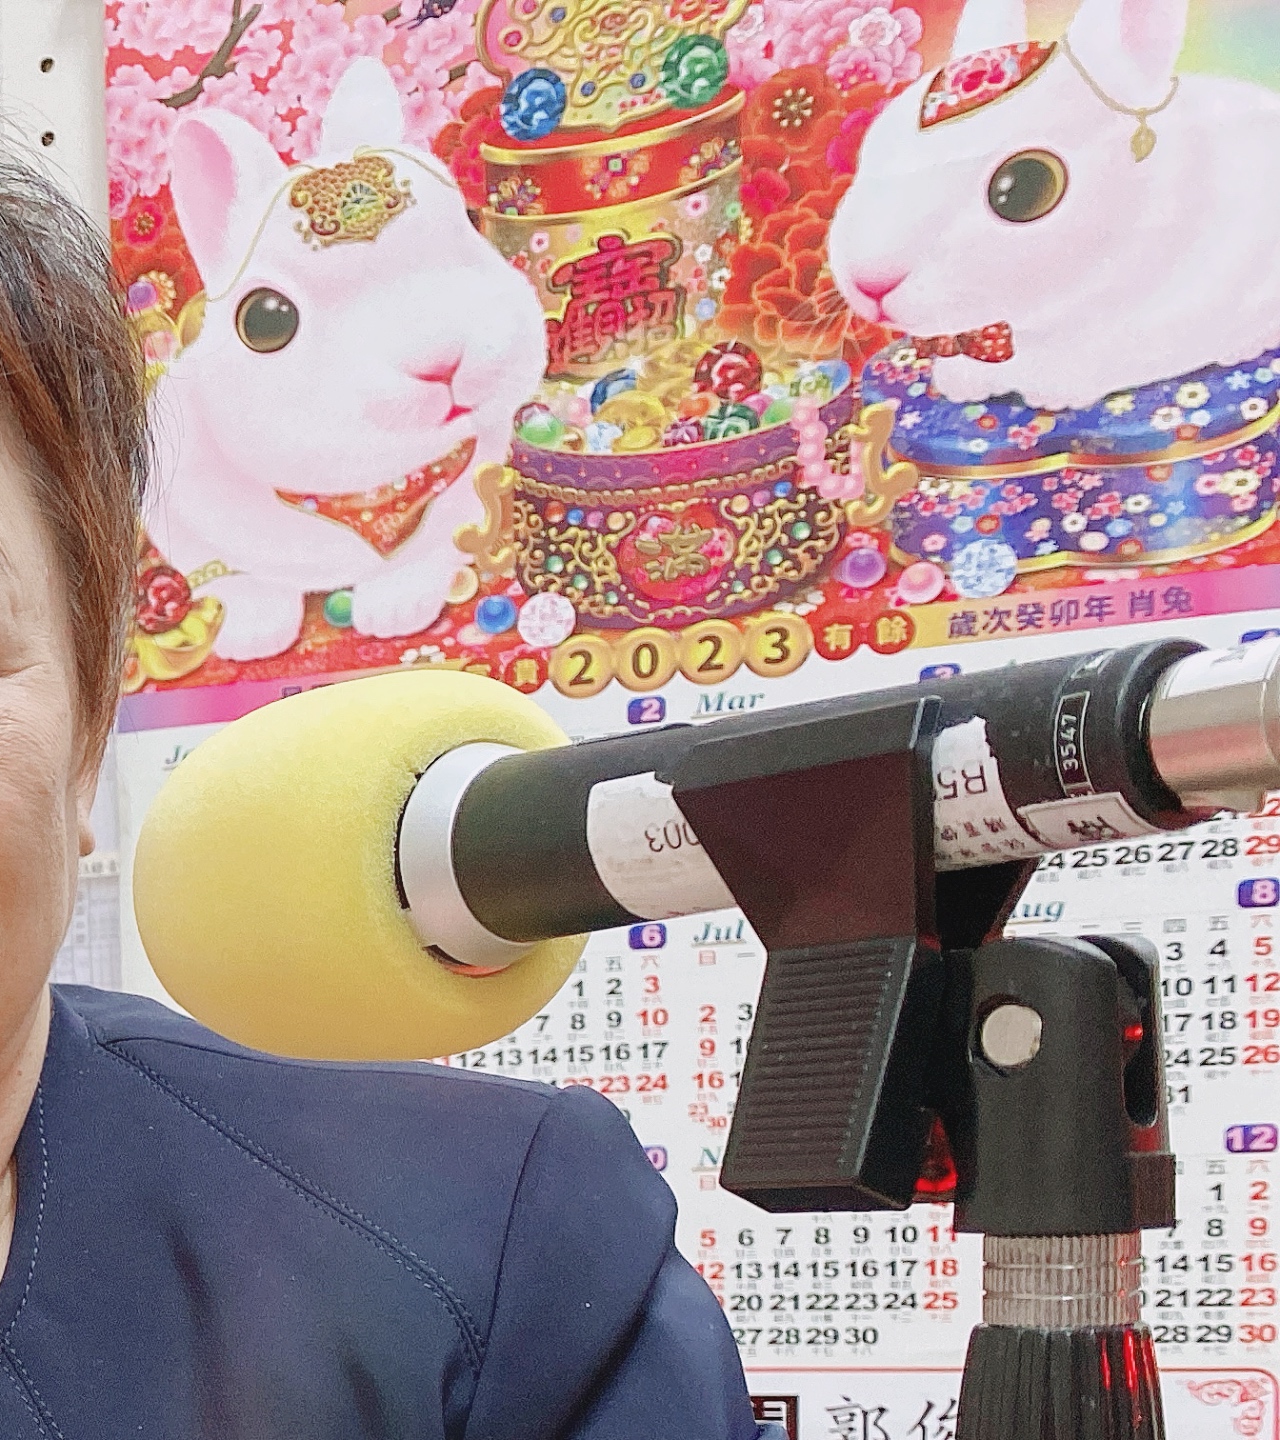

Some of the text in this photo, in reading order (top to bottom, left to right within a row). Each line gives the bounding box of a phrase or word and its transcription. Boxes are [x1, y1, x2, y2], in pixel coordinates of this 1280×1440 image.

[947, 593, 1115, 638] 歲次癸卯年
[569, 624, 792, 686] 2023
[639, 690, 766, 722] 2 Mar
[1059, 713, 1080, 772] 3547
[1072, 849, 1109, 868] 25
[1115, 845, 1151, 865] 26
[1158, 841, 1195, 862] 27
[1201, 838, 1238, 858] 28
[1244, 834, 1280, 855] 29
[1251, 879, 1276, 905] 8
[1012, 900, 1065, 920] ug
[641, 918, 744, 947] 6 Jul
[1165, 935, 1273, 961] 3 4 5
[573, 975, 660, 997] 1 2 3
[1162, 971, 1280, 996] 10 11 12
[535, 1007, 669, 1031] 7 8 9 10
[699, 1003, 753, 1023] 2 3
[1163, 1008, 1280, 1033] 17 18 19
[456, 1040, 670, 1069] 12 13 14 15 16 17
[700, 1038, 716, 1057] 9
[1199, 1046, 1237, 1066] 25
[1243, 1044, 1280, 1065] 26
[599, 1075, 631, 1094] 23
[636, 1073, 669, 1093] 24
[694, 1071, 725, 1090] 16
[1226, 1126, 1277, 1152] 12
[1208, 1180, 1269, 1201] 1 2
[700, 1225, 958, 1247] 5 6 7 8 9 10 11
[1206, 1218, 1224, 1237] 8
[1248, 1217, 1268, 1237] 9
[695, 1258, 958, 1280] 12 13 14 15 16 17 18
[1154, 1253, 1277, 1273] 14 15 16
[730, 1290, 959, 1312] 20 21 22 23 24 25
[1154, 1287, 1277, 1308] 21 22 23
[735, 1327, 763, 1346] 27
[767, 1327, 801, 1346] 28
[805, 1326, 840, 1346] 29
[844, 1326, 879, 1345] 30
[1153, 1323, 1277, 1344] 28 29 30
